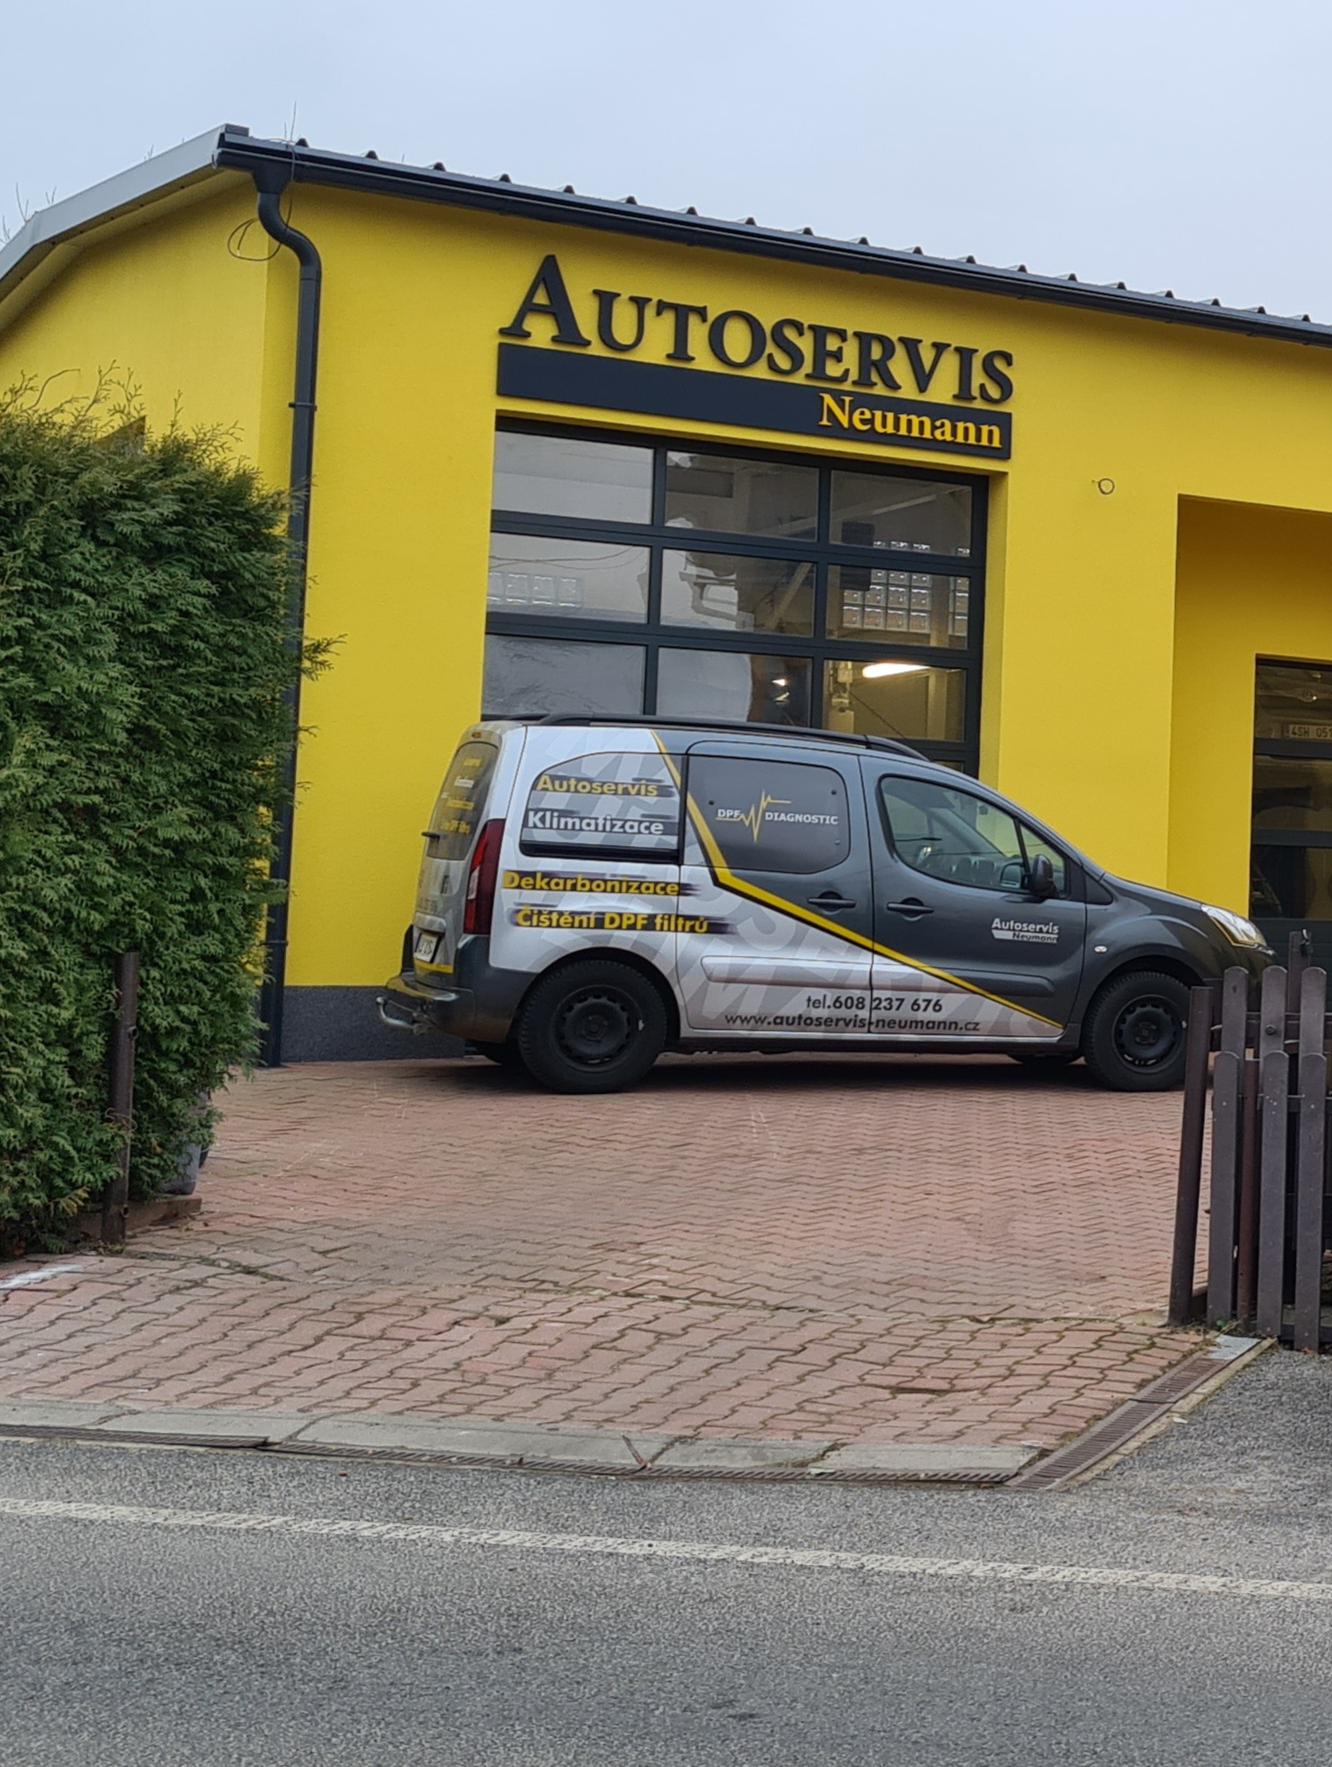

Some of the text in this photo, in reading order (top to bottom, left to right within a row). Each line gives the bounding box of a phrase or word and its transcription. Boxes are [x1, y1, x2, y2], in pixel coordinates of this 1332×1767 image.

[499, 254, 1014, 403] AUTOSERVIS
[818, 393, 1002, 449] Neumann
[536, 774, 658, 797] Autoservis
[527, 810, 664, 835] Klimatizace
[717, 808, 839, 825] DPF DIAGNOSTIC
[502, 872, 680, 897] Dekarbonizace
[515, 907, 709, 935] Čištění DPF filtrů
[991, 917, 1059, 935] Autoservis
[1012, 930, 1059, 944] Neumann
[806, 994, 943, 1013] tel.608 237 676
[724, 1014, 980, 1034] www.autoservis-neumann.cz
